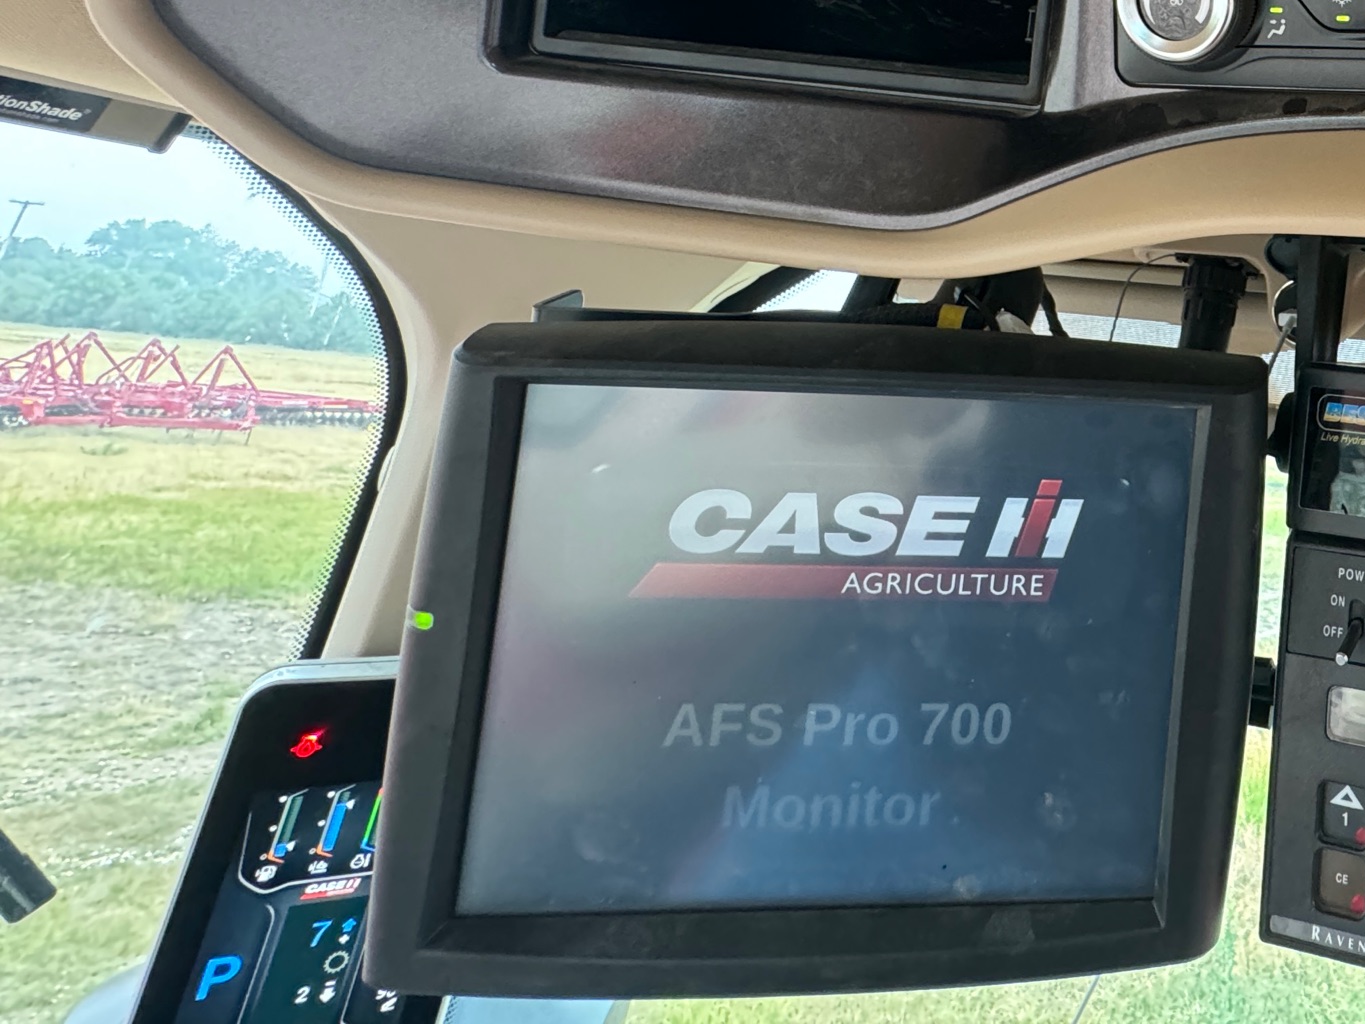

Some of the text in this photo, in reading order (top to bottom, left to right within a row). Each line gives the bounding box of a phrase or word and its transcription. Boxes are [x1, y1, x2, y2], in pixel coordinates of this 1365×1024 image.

[1321, 432, 1339, 442] Live
[668, 488, 981, 557] CASE
[841, 571, 1045, 599] AGRICULTURE
[1330, 594, 1346, 608] ON
[1323, 624, 1344, 639] OFF
[662, 701, 1012, 749] AFS Pro 700
[721, 779, 941, 830] Monitor
[1342, 811, 1348, 827] 1
[1335, 872, 1349, 885] CE
[310, 919, 333, 947] 7
[195, 955, 243, 1002] P
[294, 985, 311, 1004] 2
